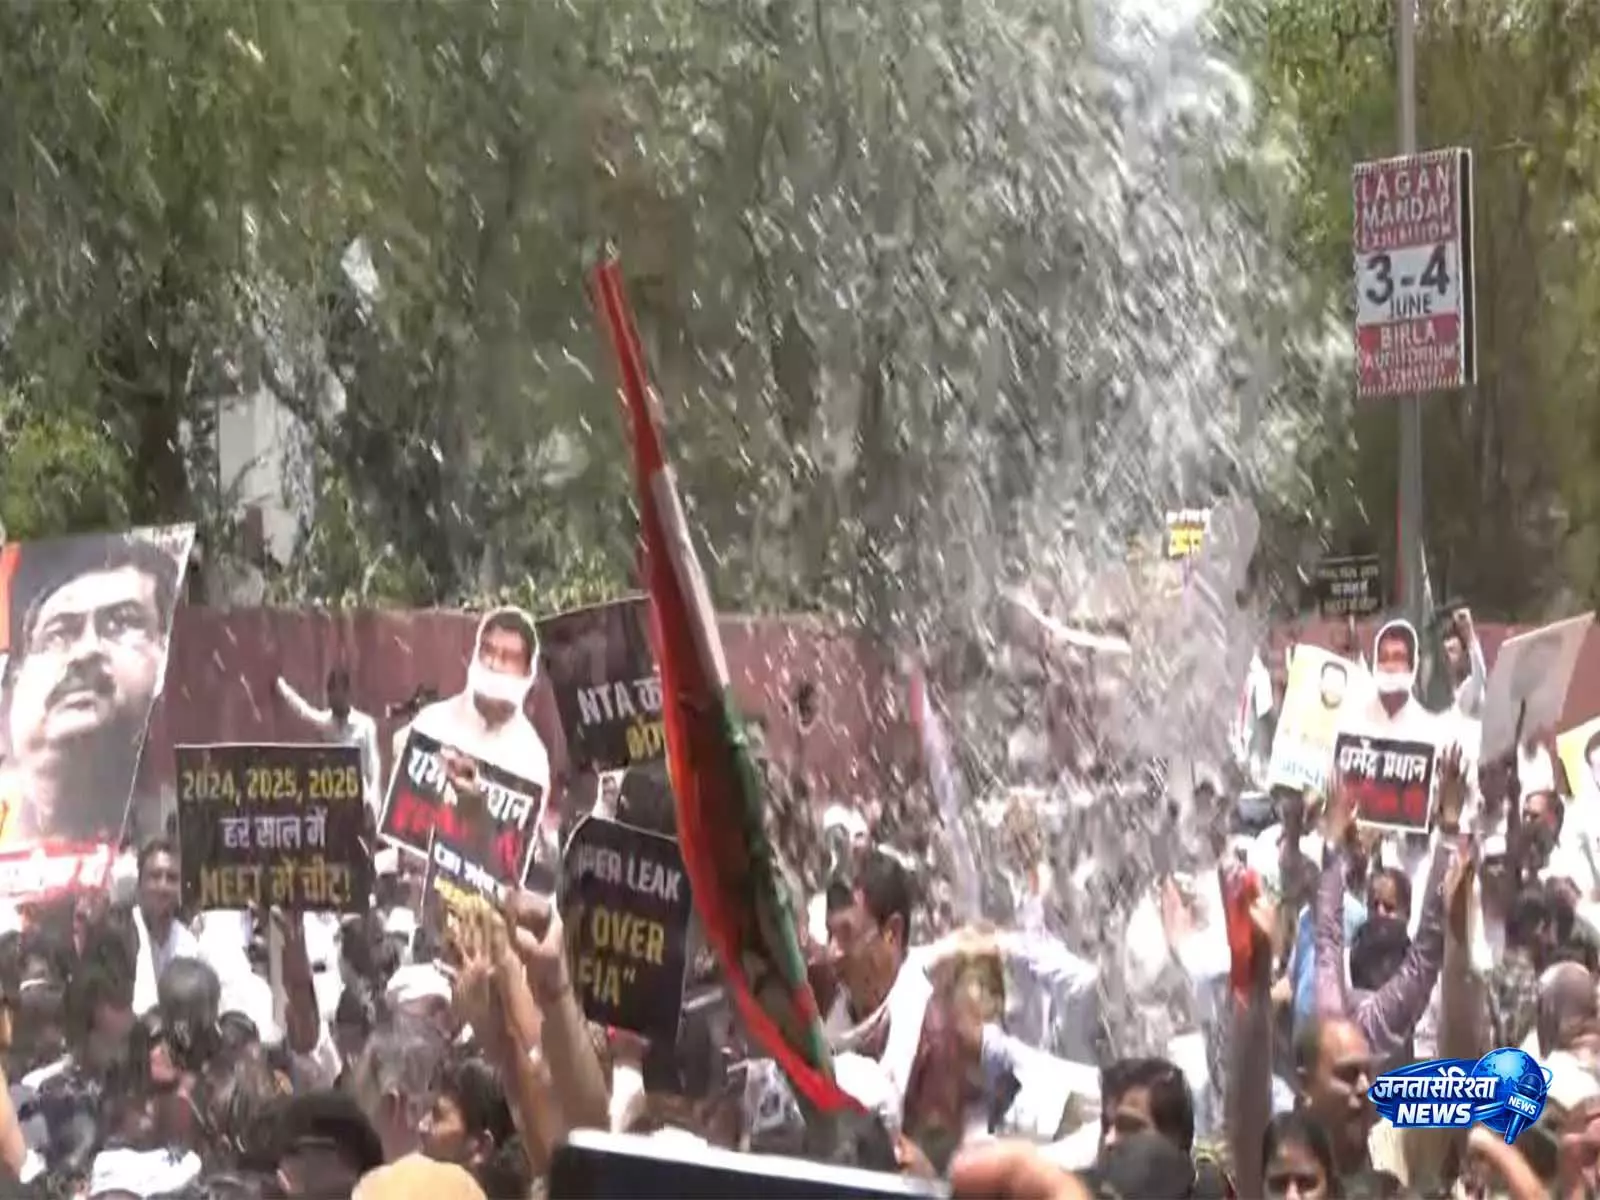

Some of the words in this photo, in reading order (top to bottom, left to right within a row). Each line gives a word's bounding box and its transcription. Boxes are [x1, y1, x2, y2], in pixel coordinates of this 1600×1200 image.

[1362, 164, 1450, 203] LAGAN
[1363, 195, 1450, 229] MANDAP
[1366, 246, 1450, 305] 3-4
[1389, 292, 1433, 319] JUNE
[1381, 319, 1436, 348] BIRLA
[577, 679, 636, 726] NTA
[182, 769, 242, 806] 2024,
[246, 765, 304, 804] 2025,
[307, 764, 359, 799] 2026
[219, 817, 250, 848] हर
[254, 815, 301, 849] साल
[304, 804, 329, 848] में
[200, 861, 262, 906] NEET
[627, 852, 682, 901] LEAK
[592, 904, 665, 966] OVER
